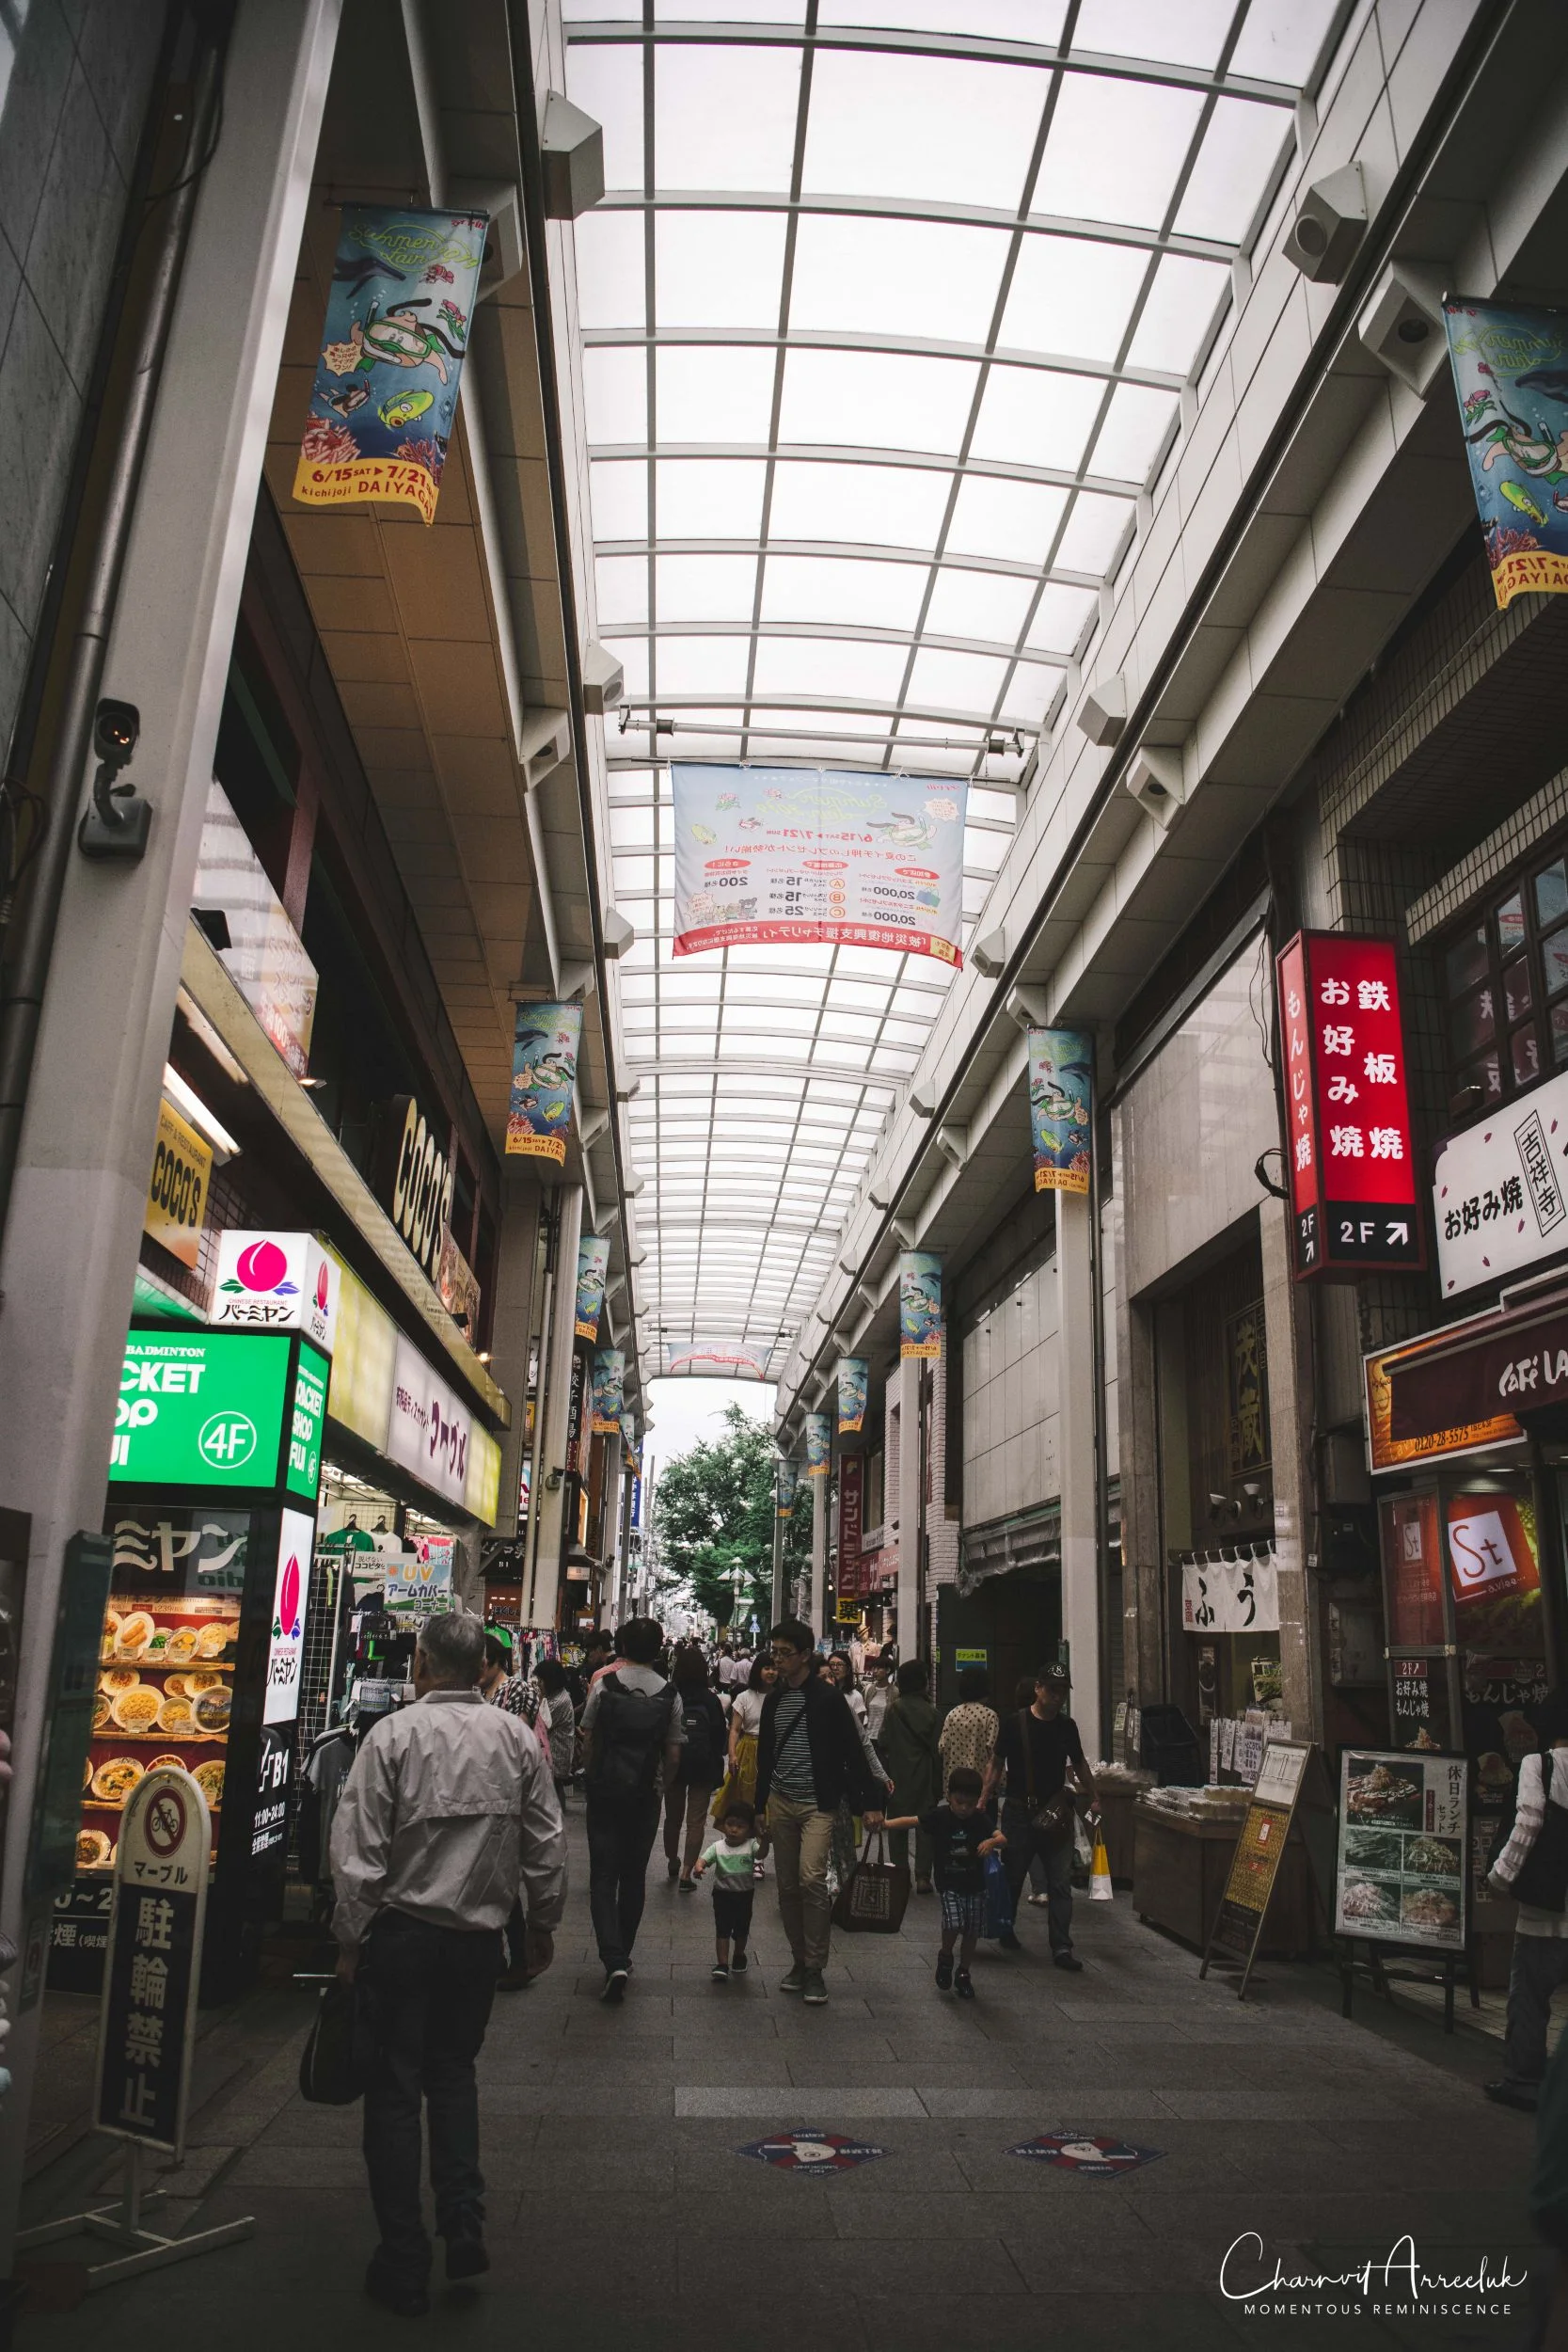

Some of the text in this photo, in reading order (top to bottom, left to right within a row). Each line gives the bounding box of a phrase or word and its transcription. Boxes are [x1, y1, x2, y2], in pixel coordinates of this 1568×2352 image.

[312, 468, 353, 483] 6/15
[354, 469, 371, 477] SAT
[388, 466, 426, 486] 7/21
[302, 486, 351, 498] kichijoji
[1287, 991, 1312, 1172] もんじゃ焼
[1322, 977, 1364, 1158] お好み焼
[1357, 979, 1404, 1160] 鉄板焼
[151, 1140, 201, 1228] COCO'S
[1522, 1129, 1556, 1216] 吉祥寺
[1445, 1176, 1523, 1241] お好み焼
[1302, 1213, 1314, 1239] 2F
[1340, 1221, 1375, 1244] 2F
[218, 1304, 295, 1322] バーミヤン
[125, 1345, 206, 1358] BADMINTON
[119, 1360, 206, 1393] CKET
[295, 1379, 323, 1418] RACKET
[293, 1409, 313, 1442] SHOP
[1415, 1428, 1469, 1453] 0120-28-5575
[204, 1423, 249, 1459] 4F
[289, 1441, 307, 1472] FUJI
[113, 1520, 247, 1573] ミヤン
[1453, 1525, 1502, 1579] St
[403, 1565, 435, 1581] UV
[388, 1583, 447, 1597] アームカバー
[414, 1599, 447, 1611] コーナー
[839, 1600, 860, 1620] 薬
[266, 1657, 297, 1687] バーミヤン
[1402, 1662, 1412, 1675] 2F
[1396, 1680, 1428, 1697] お好み焼
[1396, 1699, 1429, 1718] もんじゃ焼
[273, 1748, 290, 1788] B1
[1448, 1766, 1462, 1835] 休日ランチ
[1437, 1804, 1446, 1833] セット
[119, 1897, 175, 2129] 駐輪禁止
